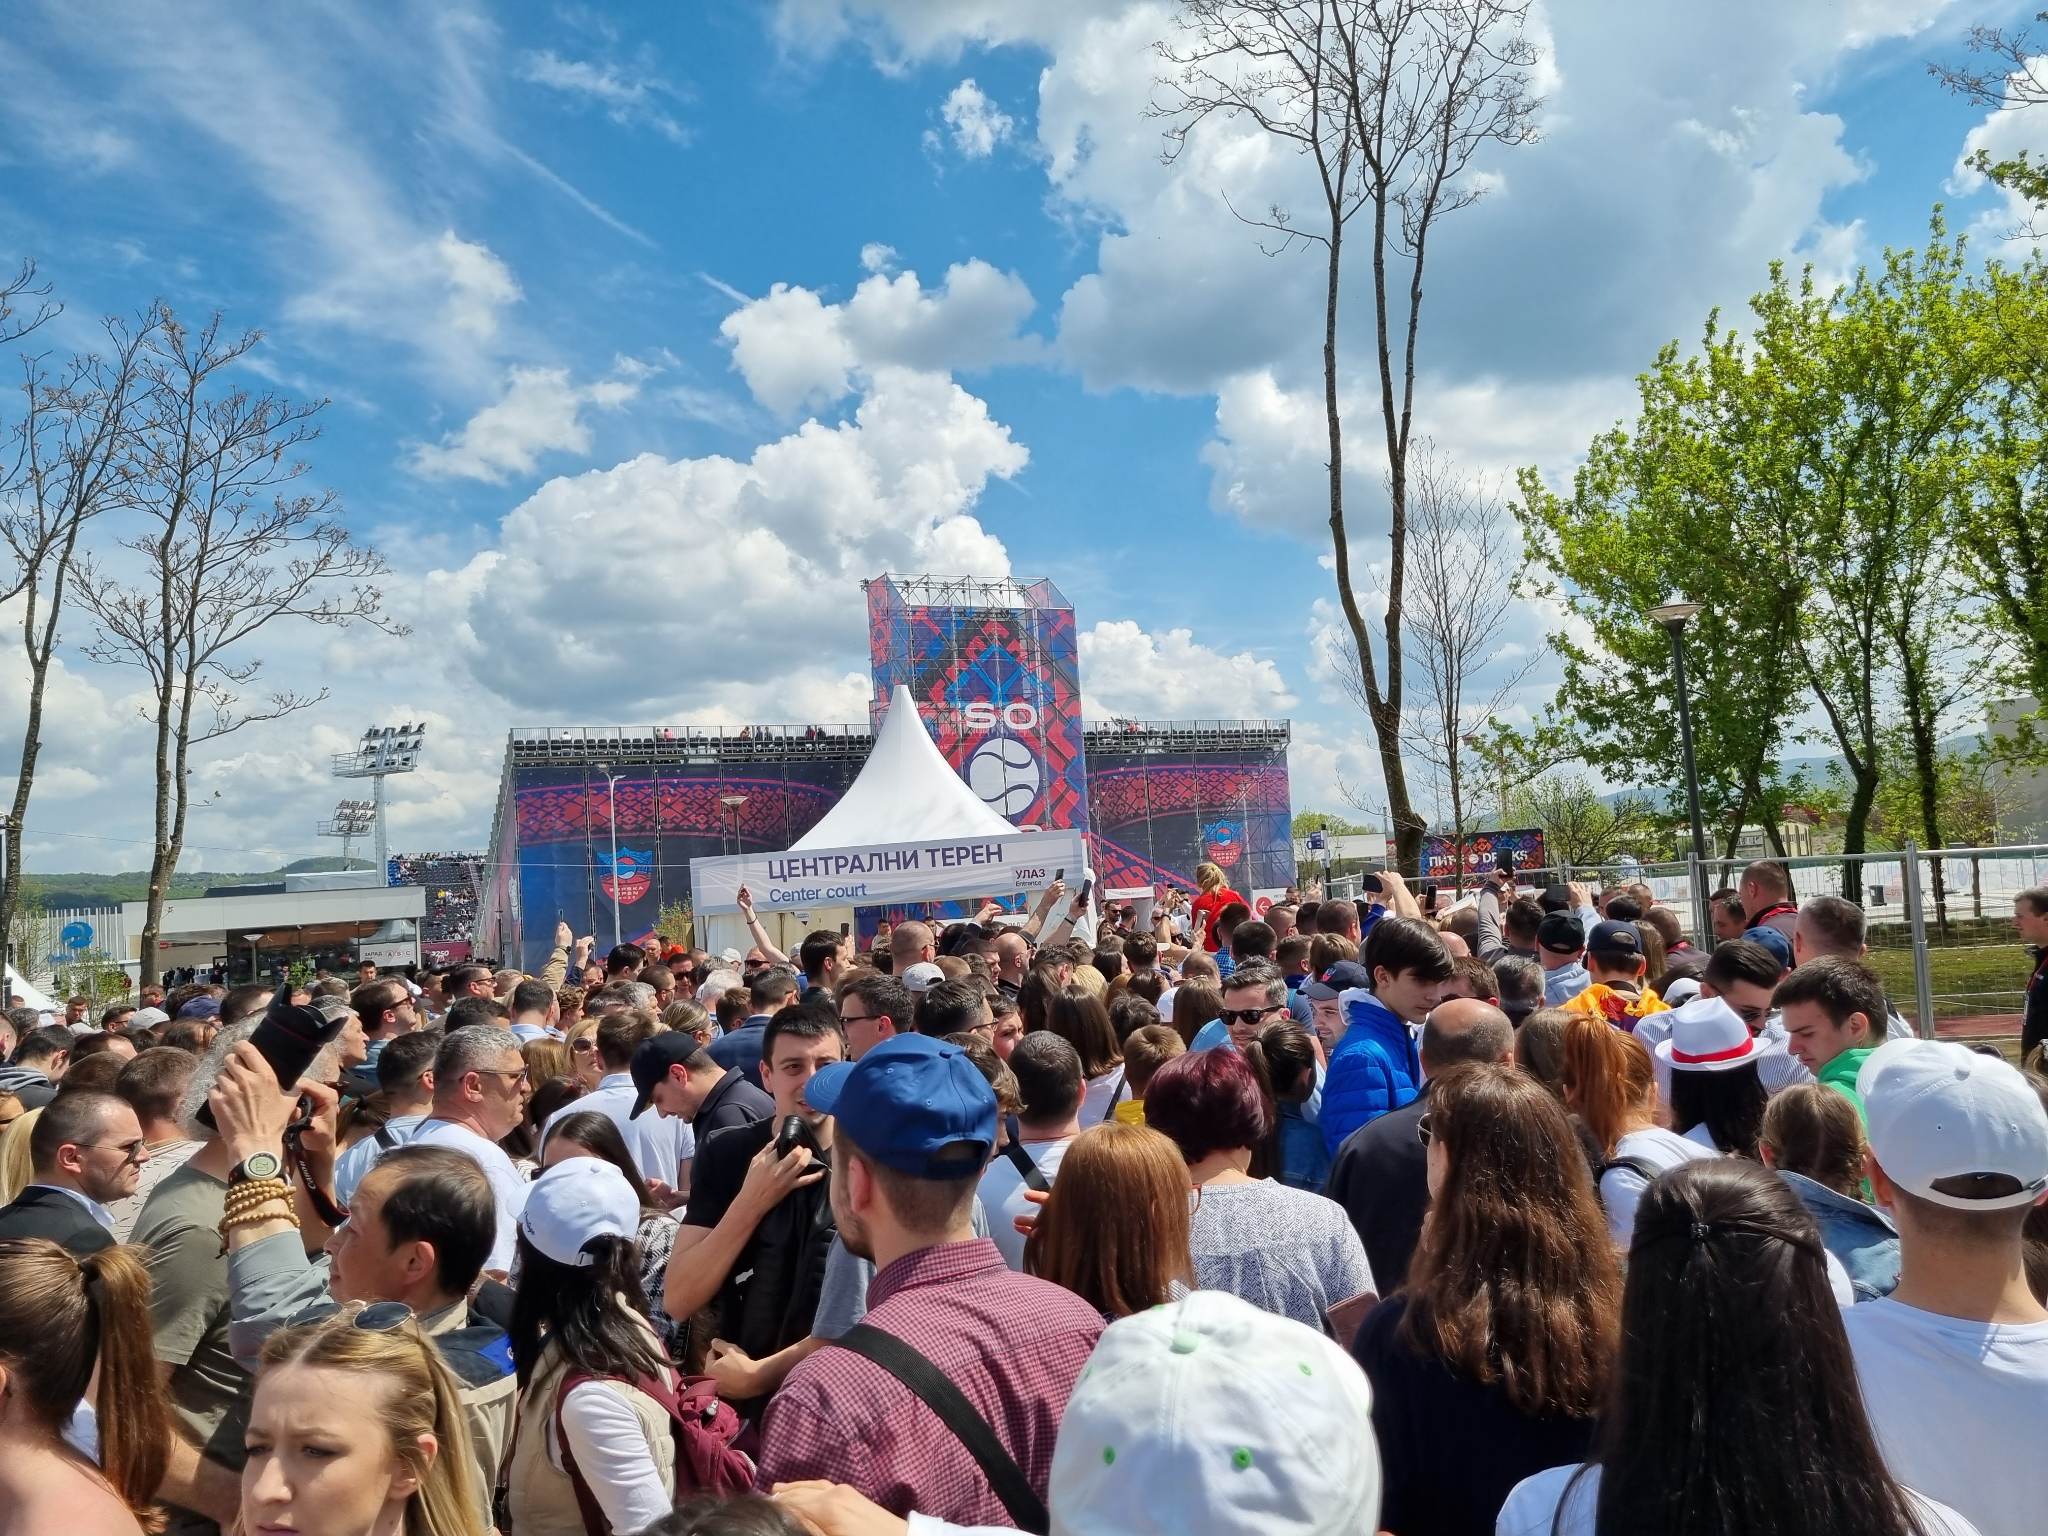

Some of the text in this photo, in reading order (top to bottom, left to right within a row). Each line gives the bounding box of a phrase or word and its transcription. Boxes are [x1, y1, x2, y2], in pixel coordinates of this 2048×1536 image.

[965, 703, 1038, 730] SO
[768, 843, 1003, 882] ЦЕНТРАЛНИ ТЕРЕН
[1483, 850, 1528, 863] DRKS
[1015, 868, 1046, 880] УЛАЗ
[769, 883, 867, 903] Center court
[299, 1160, 316, 1190] Canon
